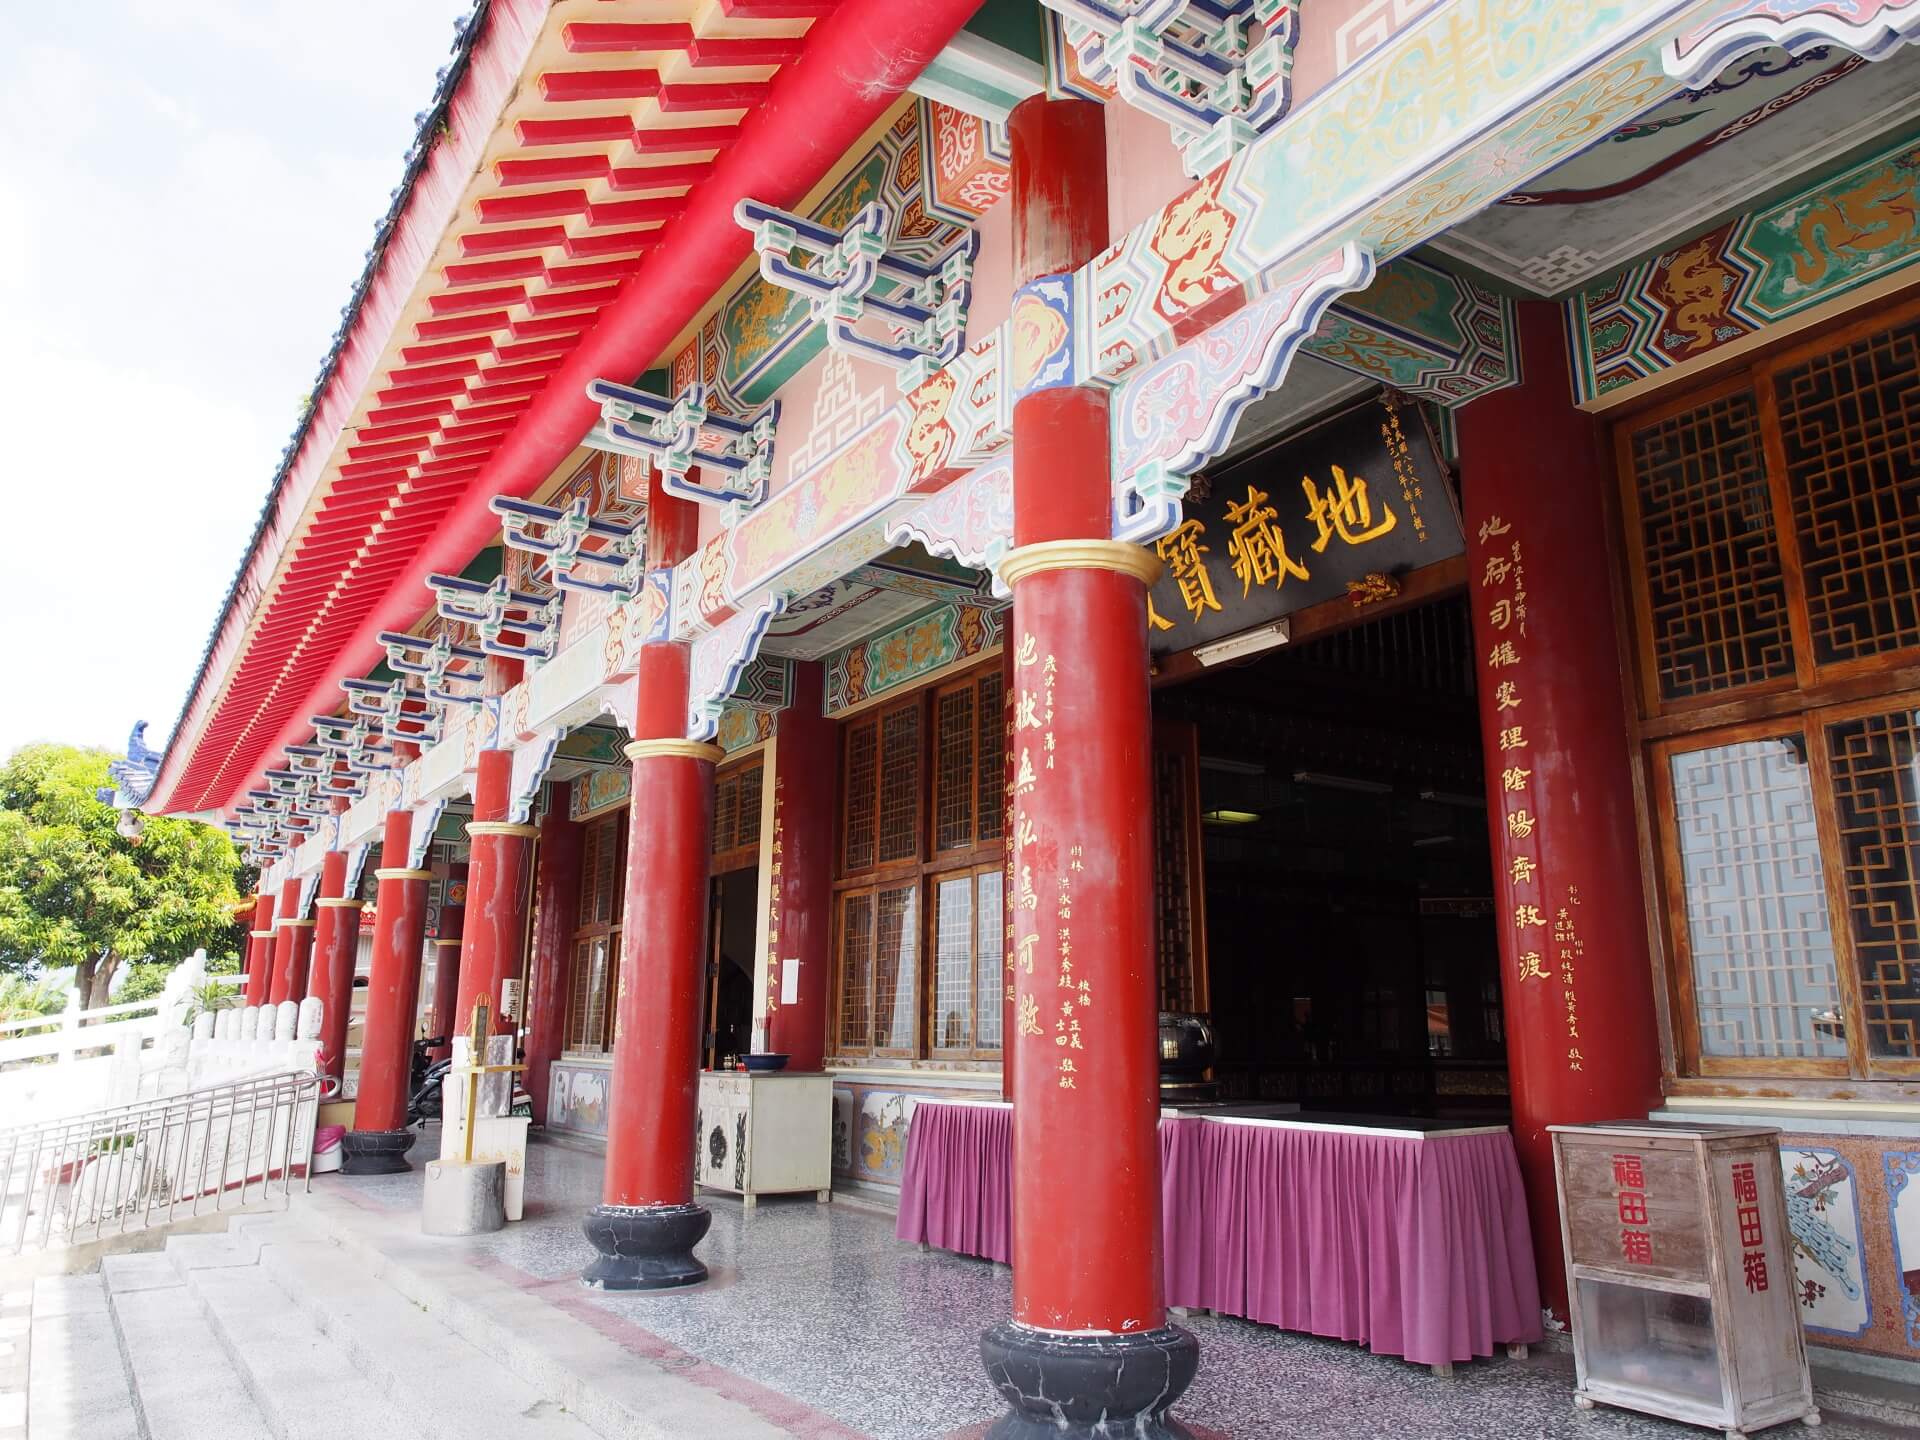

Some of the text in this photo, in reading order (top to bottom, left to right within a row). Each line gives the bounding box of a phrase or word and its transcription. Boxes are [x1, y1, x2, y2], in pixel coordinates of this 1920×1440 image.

[1147, 464, 1397, 632] 地藏寶
[1613, 1154, 1653, 1265] 福田箱
[1731, 1162, 1769, 1294] 福田箱
